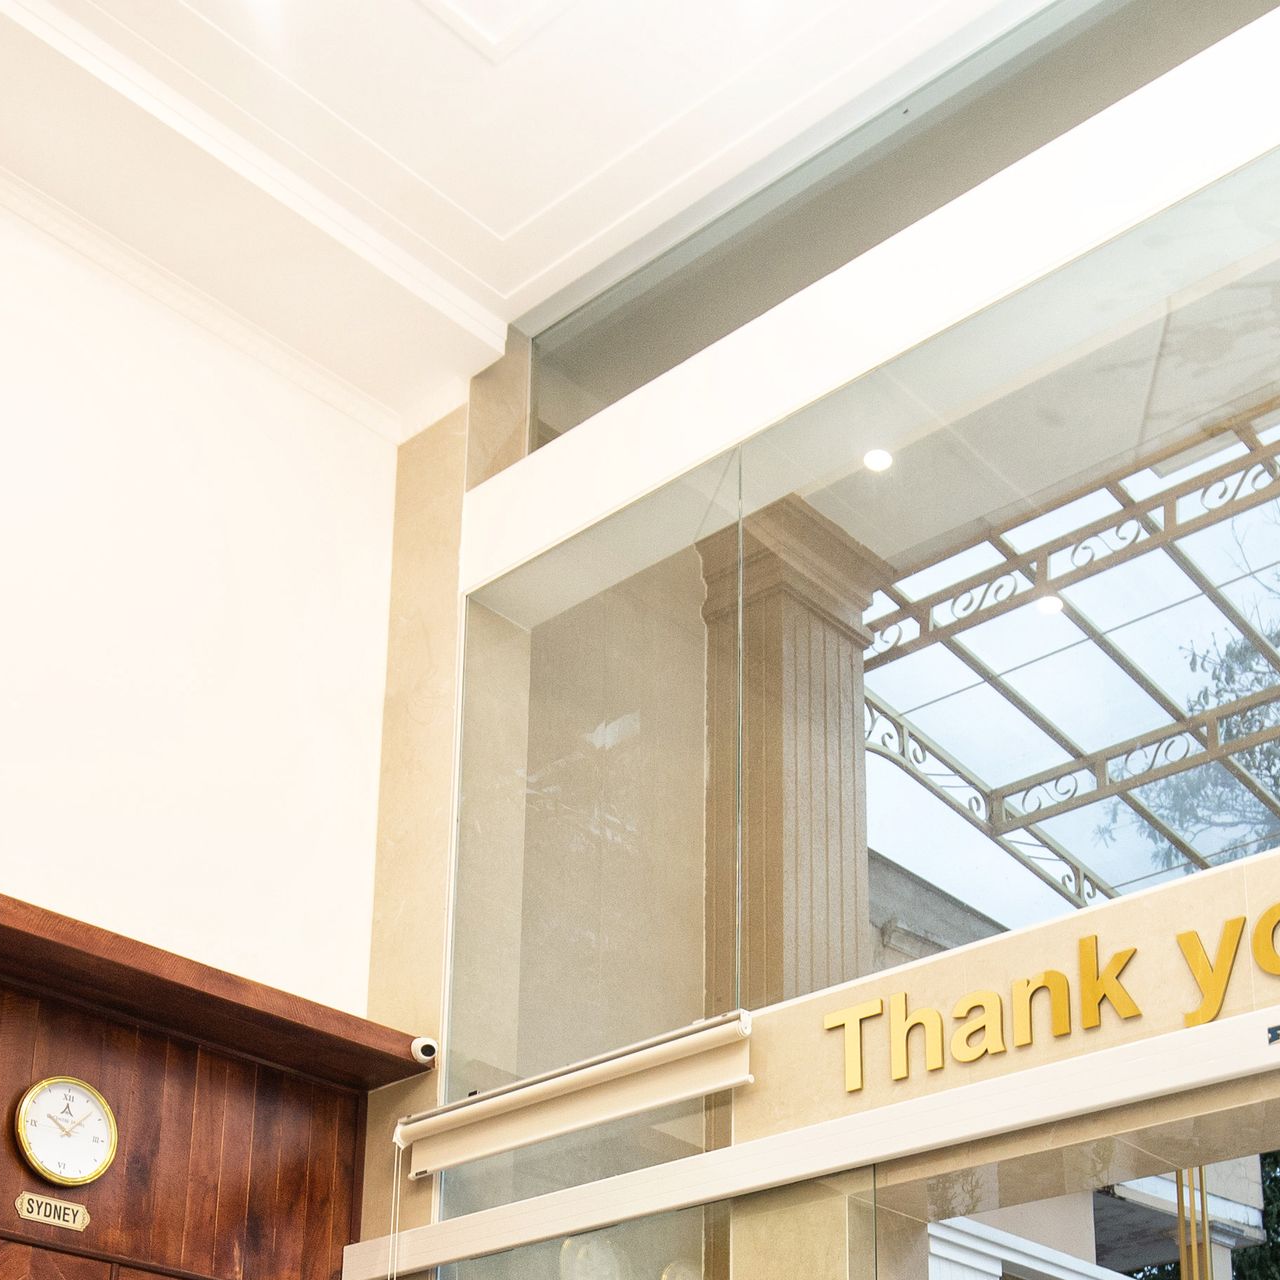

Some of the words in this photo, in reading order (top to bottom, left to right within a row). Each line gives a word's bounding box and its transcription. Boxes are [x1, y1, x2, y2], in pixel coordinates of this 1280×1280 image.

[824, 935, 1143, 1092] Thank
[57, 1161, 66, 1170] VI
[27, 1198, 79, 1224] SYDNEY
